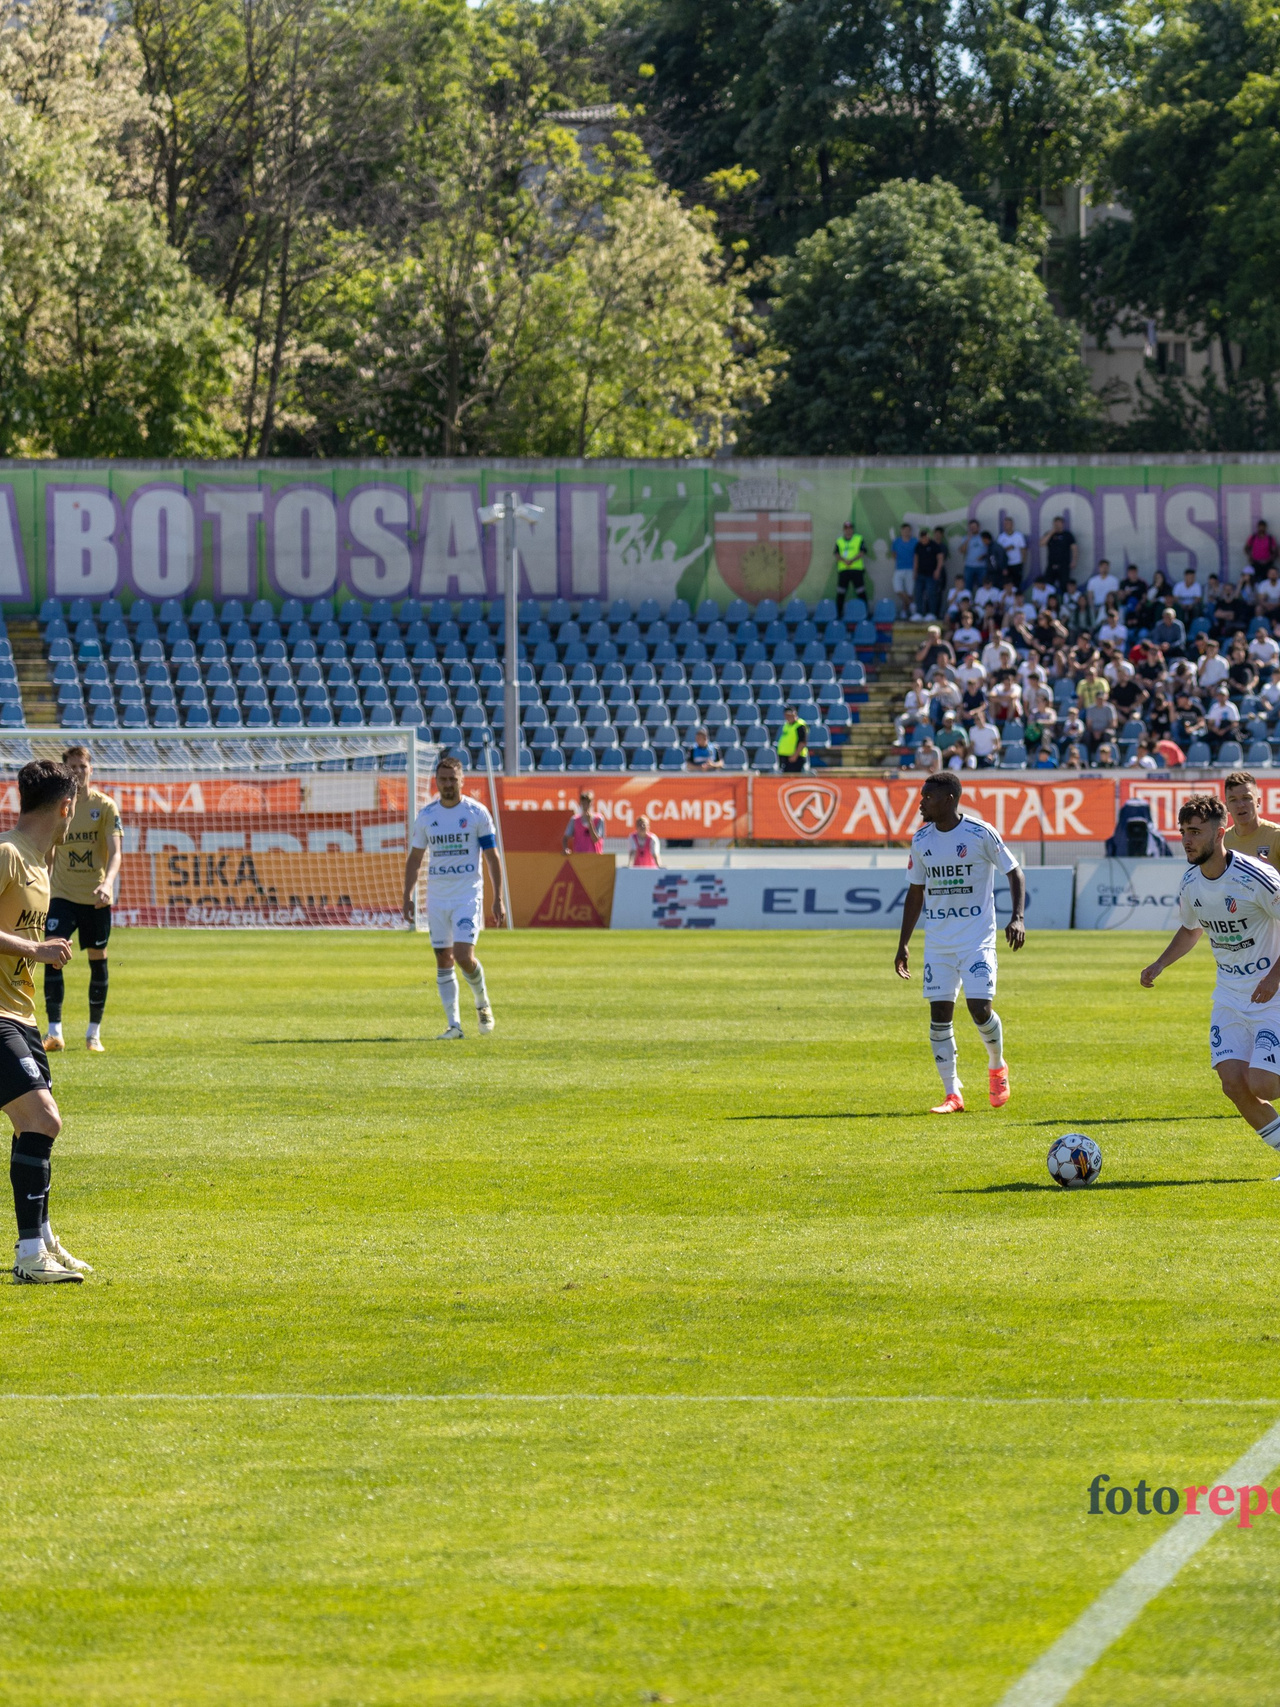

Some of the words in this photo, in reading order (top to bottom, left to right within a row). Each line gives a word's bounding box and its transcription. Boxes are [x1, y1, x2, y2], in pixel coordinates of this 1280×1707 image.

[49, 485, 604, 600] BOTOSANI
[66, 831, 98, 841] AXBET
[430, 833, 470, 845] UNIBET
[167, 855, 260, 887] SIKA
[428, 863, 475, 875] ELSACO
[925, 864, 973, 878] UNIBET
[539, 881, 593, 921] Sika
[762, 887, 1032, 914] ELSAO
[1098, 895, 1181, 907] ELSAC
[16, 909, 47, 927] MAXB
[186, 906, 307, 925] SUPERLIGA
[923, 963, 933, 984] 3
[1215, 1048, 1234, 1058] Vestra
